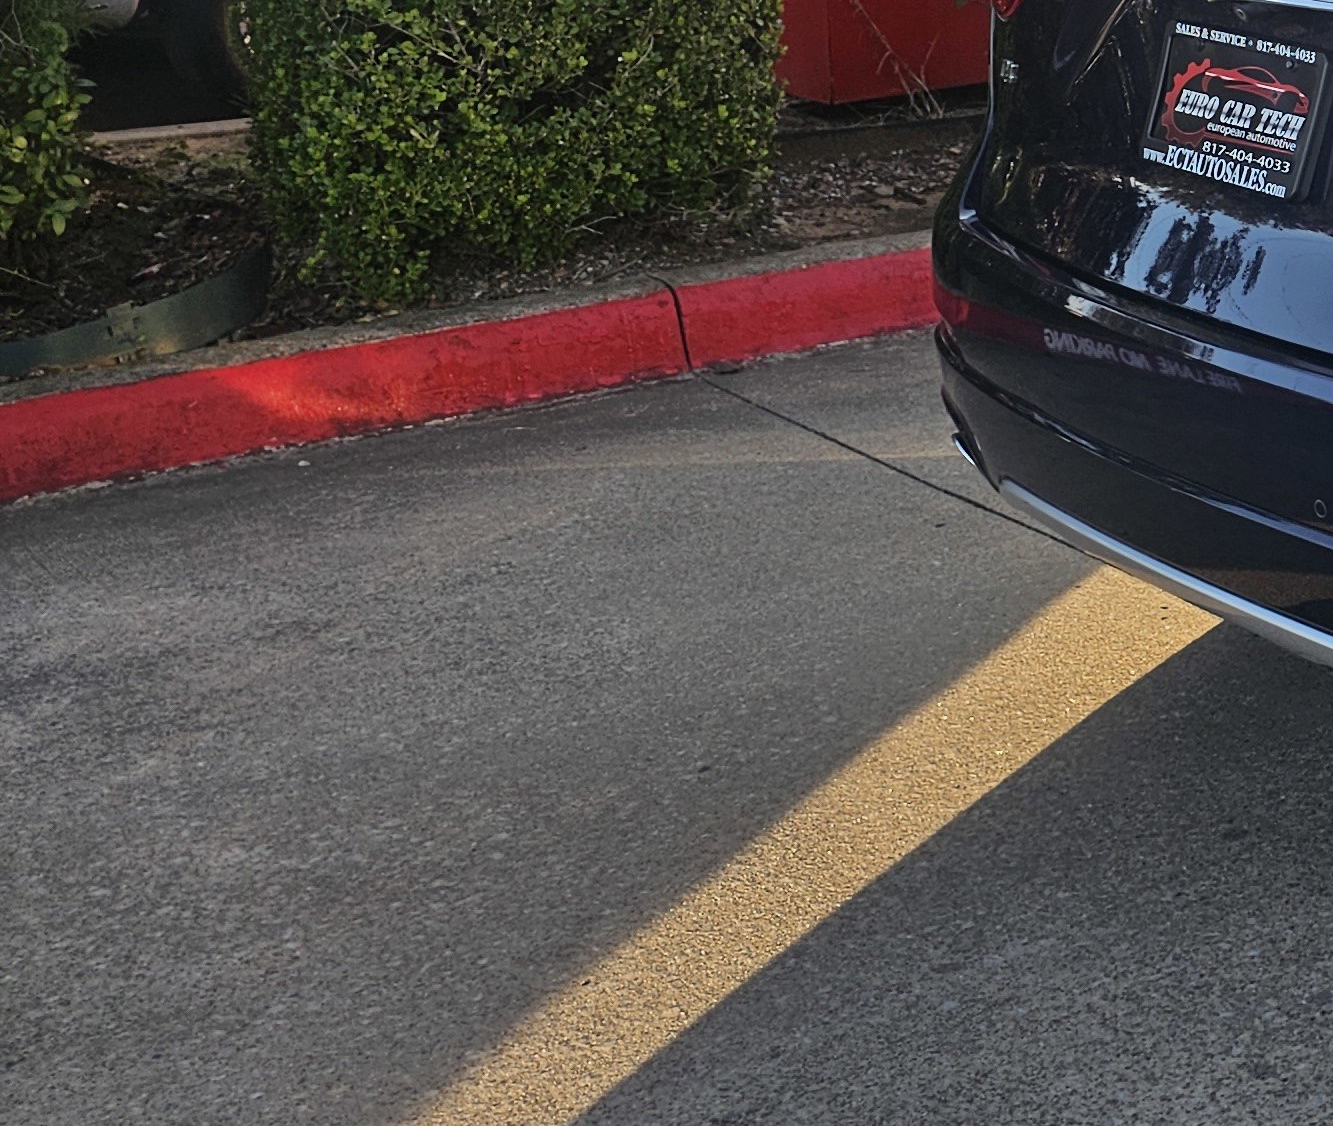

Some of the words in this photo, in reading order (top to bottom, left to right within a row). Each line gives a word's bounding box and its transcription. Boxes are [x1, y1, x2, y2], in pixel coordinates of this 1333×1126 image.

[1175, 23, 1201, 39] SALES
[1201, 27, 1209, 39] &
[1210, 29, 1247, 48] SERVICE
[1256, 39, 1317, 64] 817-404-4033
[1175, 88, 1220, 119] EURO
[1219, 99, 1257, 129] CAR
[1256, 108, 1307, 141] TECH
[1202, 141, 1291, 174] 817-404-4033
[1206, 122, 1246, 139] european
[1246, 132, 1297, 152] automotive
[1143, 145, 1287, 199] www.ECTAUTOSALES.com
